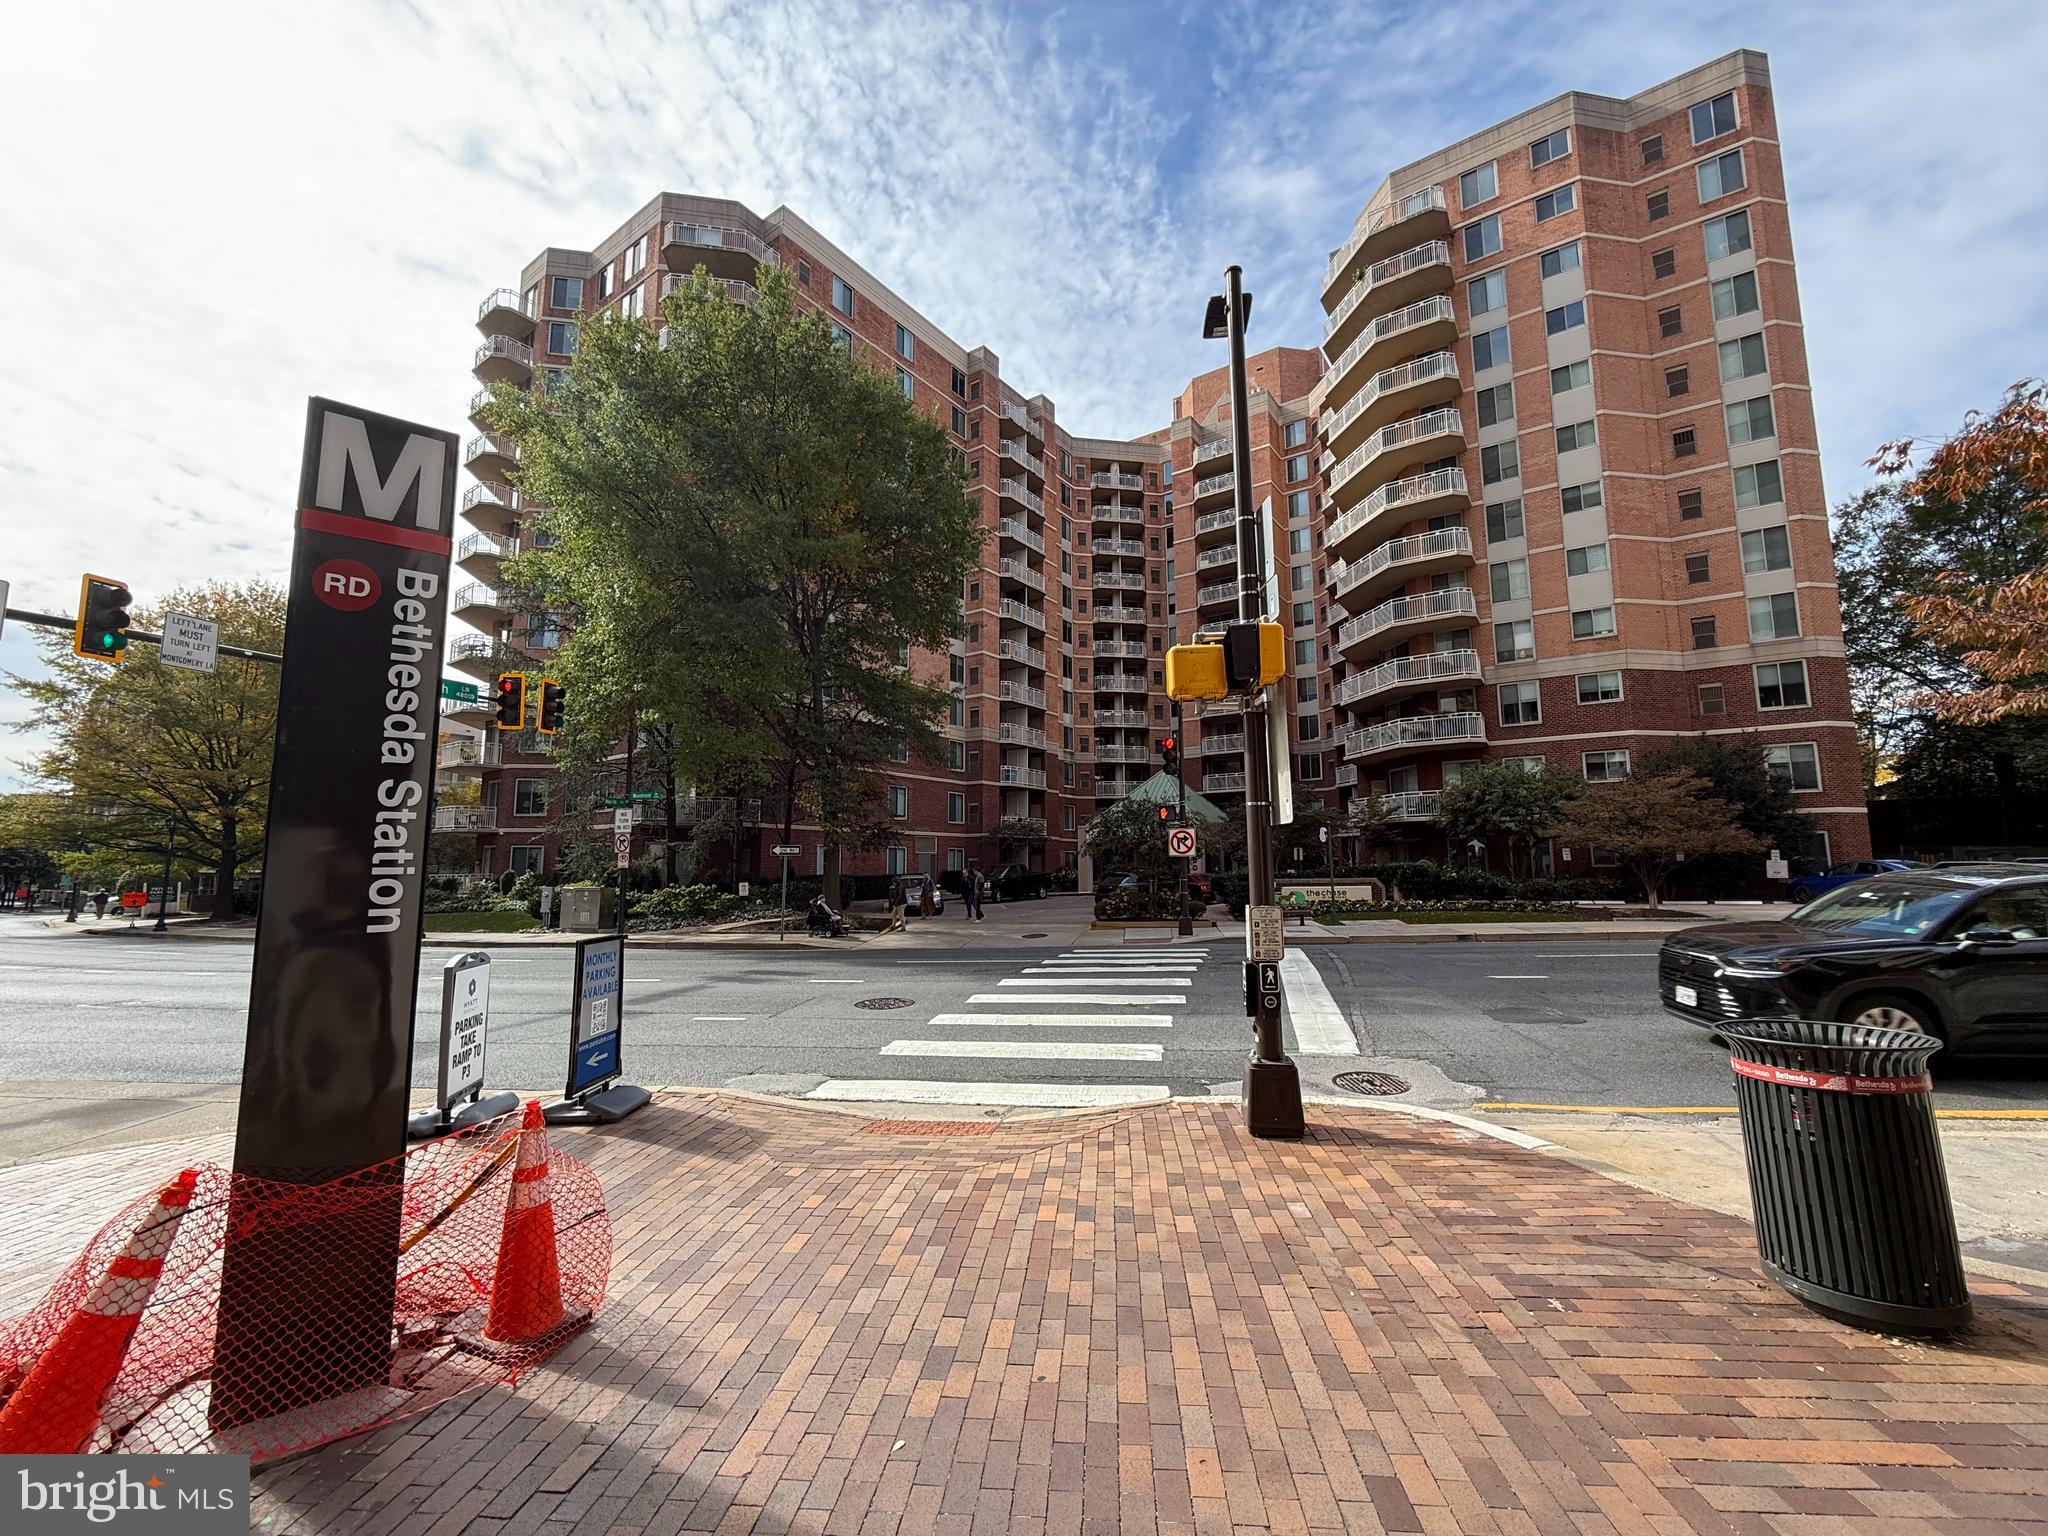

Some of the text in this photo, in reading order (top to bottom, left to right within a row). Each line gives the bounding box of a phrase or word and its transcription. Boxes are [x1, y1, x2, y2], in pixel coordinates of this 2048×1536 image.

[315, 411, 446, 531] M
[324, 572, 371, 598] RD
[173, 617, 212, 632] LEFT LANE
[180, 629, 204, 641] MUST
[170, 638, 211, 652] TURN LEFT
[162, 654, 203, 667] MONTGOMERY
[366, 568, 439, 934] Bethesda Station
[585, 951, 617, 967] MONTHLY
[586, 966, 616, 983] PARKING
[583, 980, 618, 1000] AVAILABLE
[455, 1012, 483, 1036] PARKING
[461, 1030, 476, 1049] TAKE
[452, 1043, 481, 1069] RAMP TO
[462, 1064, 471, 1080] P3
[1775, 1071, 1809, 1083] Bethesda
[1855, 1080, 1890, 1088] Bethesda
